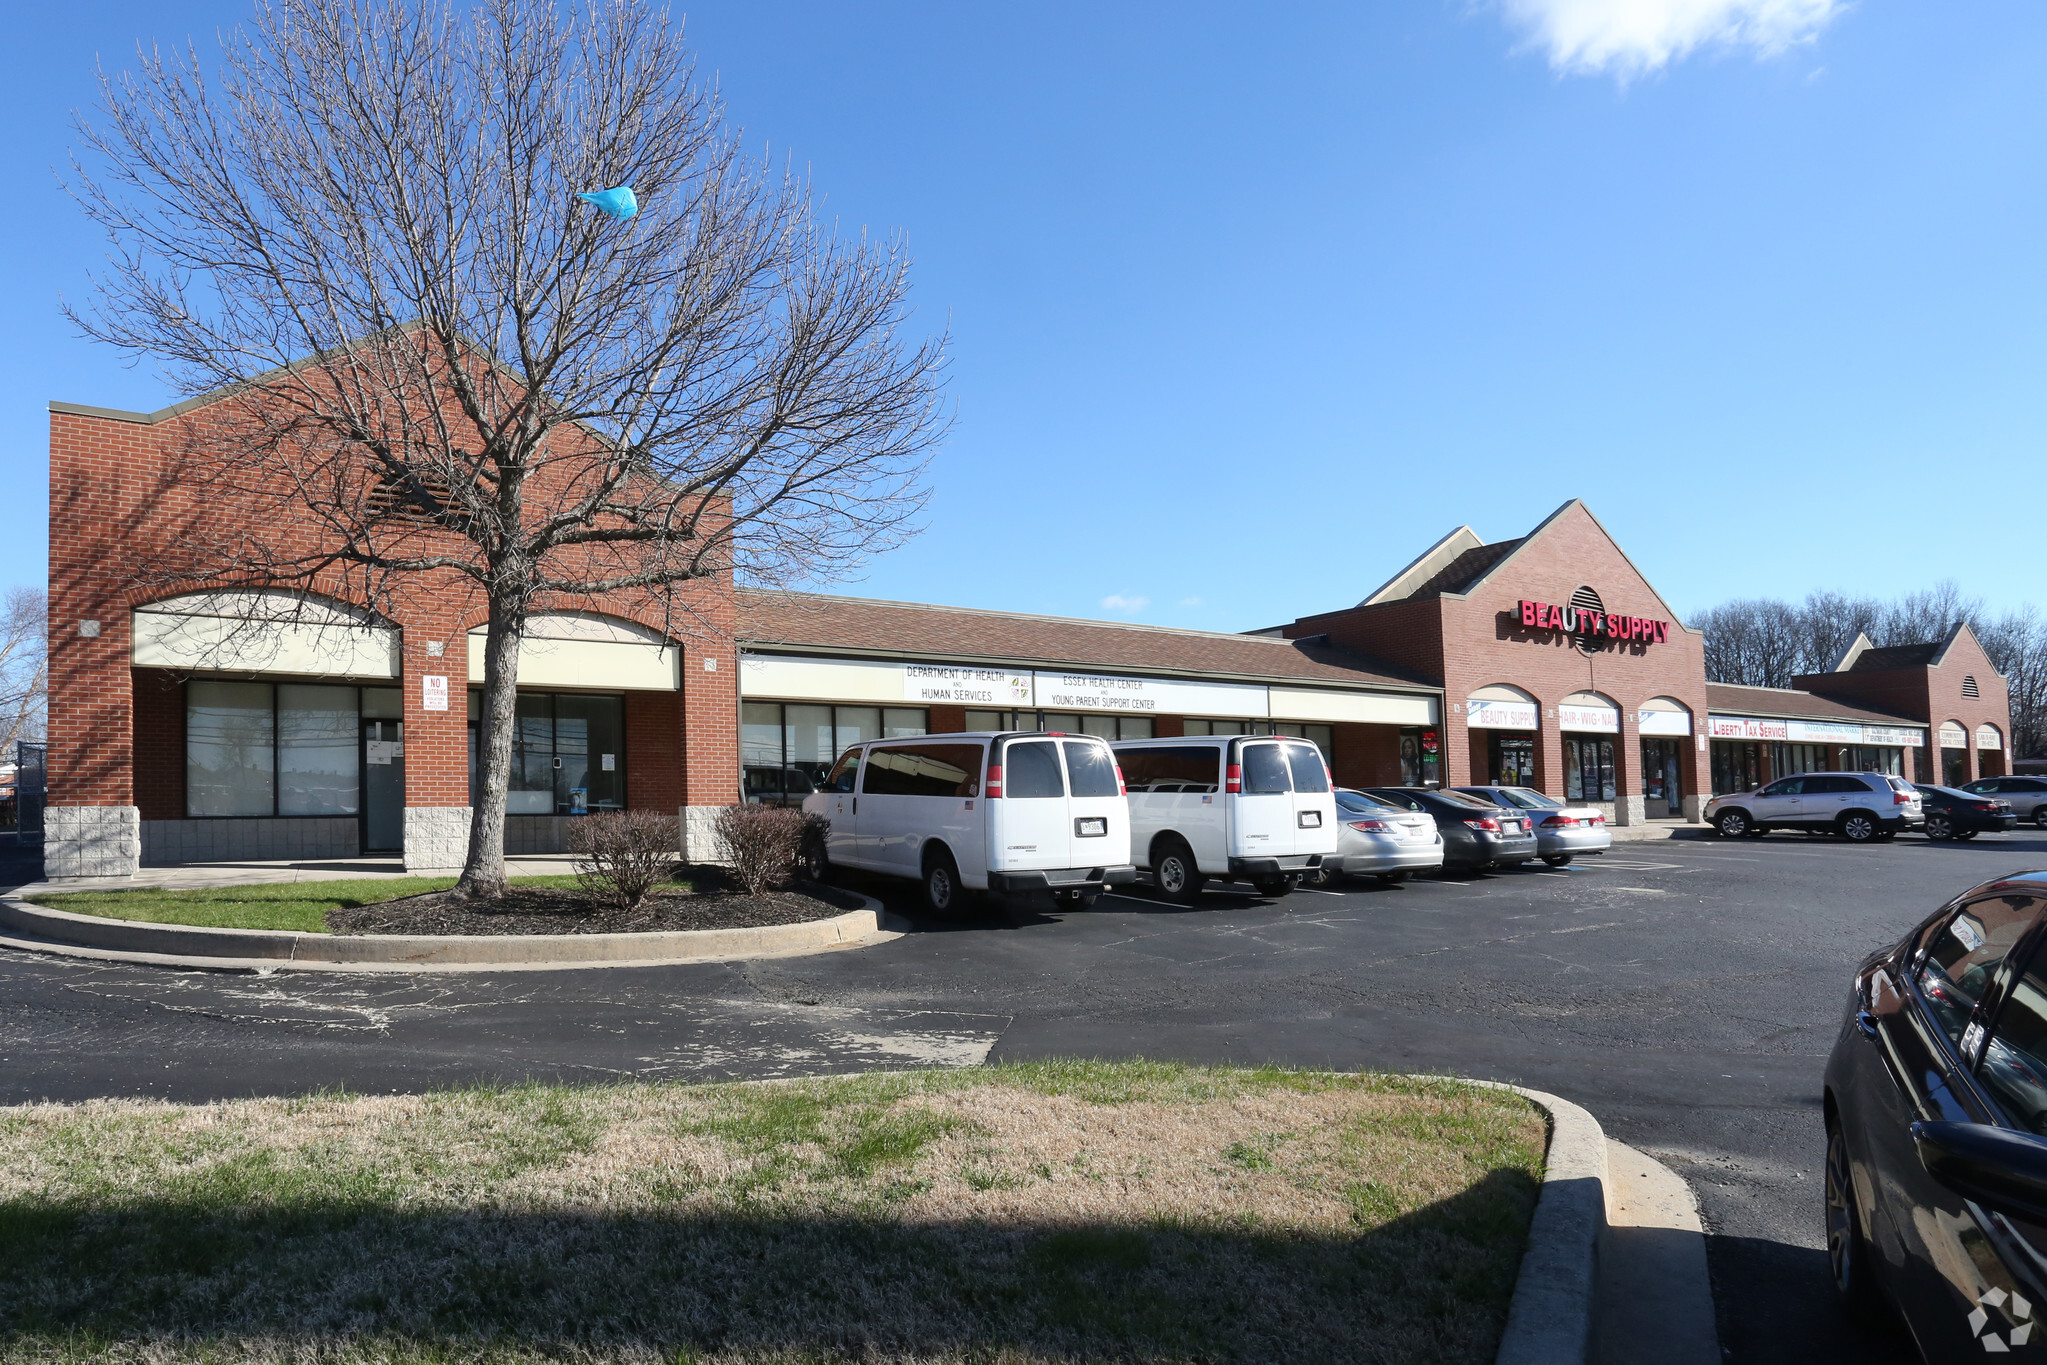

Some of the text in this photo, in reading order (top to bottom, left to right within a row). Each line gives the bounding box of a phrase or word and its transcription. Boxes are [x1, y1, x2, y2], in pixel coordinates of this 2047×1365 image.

[1519, 600, 1669, 643] BEAUTY SUPPLY
[907, 666, 1005, 682] DEPARTMENT OF HEALTH
[430, 678, 440, 688] NO
[1063, 675, 1143, 690] ESSEX HEALTH CENTER
[425, 688, 446, 696] LOITERING
[921, 688, 992, 702] HUMAN SERVICES
[1051, 695, 1156, 710] YOUNG PARENT SUPPORT CENTER
[1480, 710, 1536, 726] BEAUTY SUPPLY
[1713, 719, 1742, 736] LIBERTY
[1743, 720, 1758, 737] TAX
[1759, 721, 1786, 738] SERVICE
